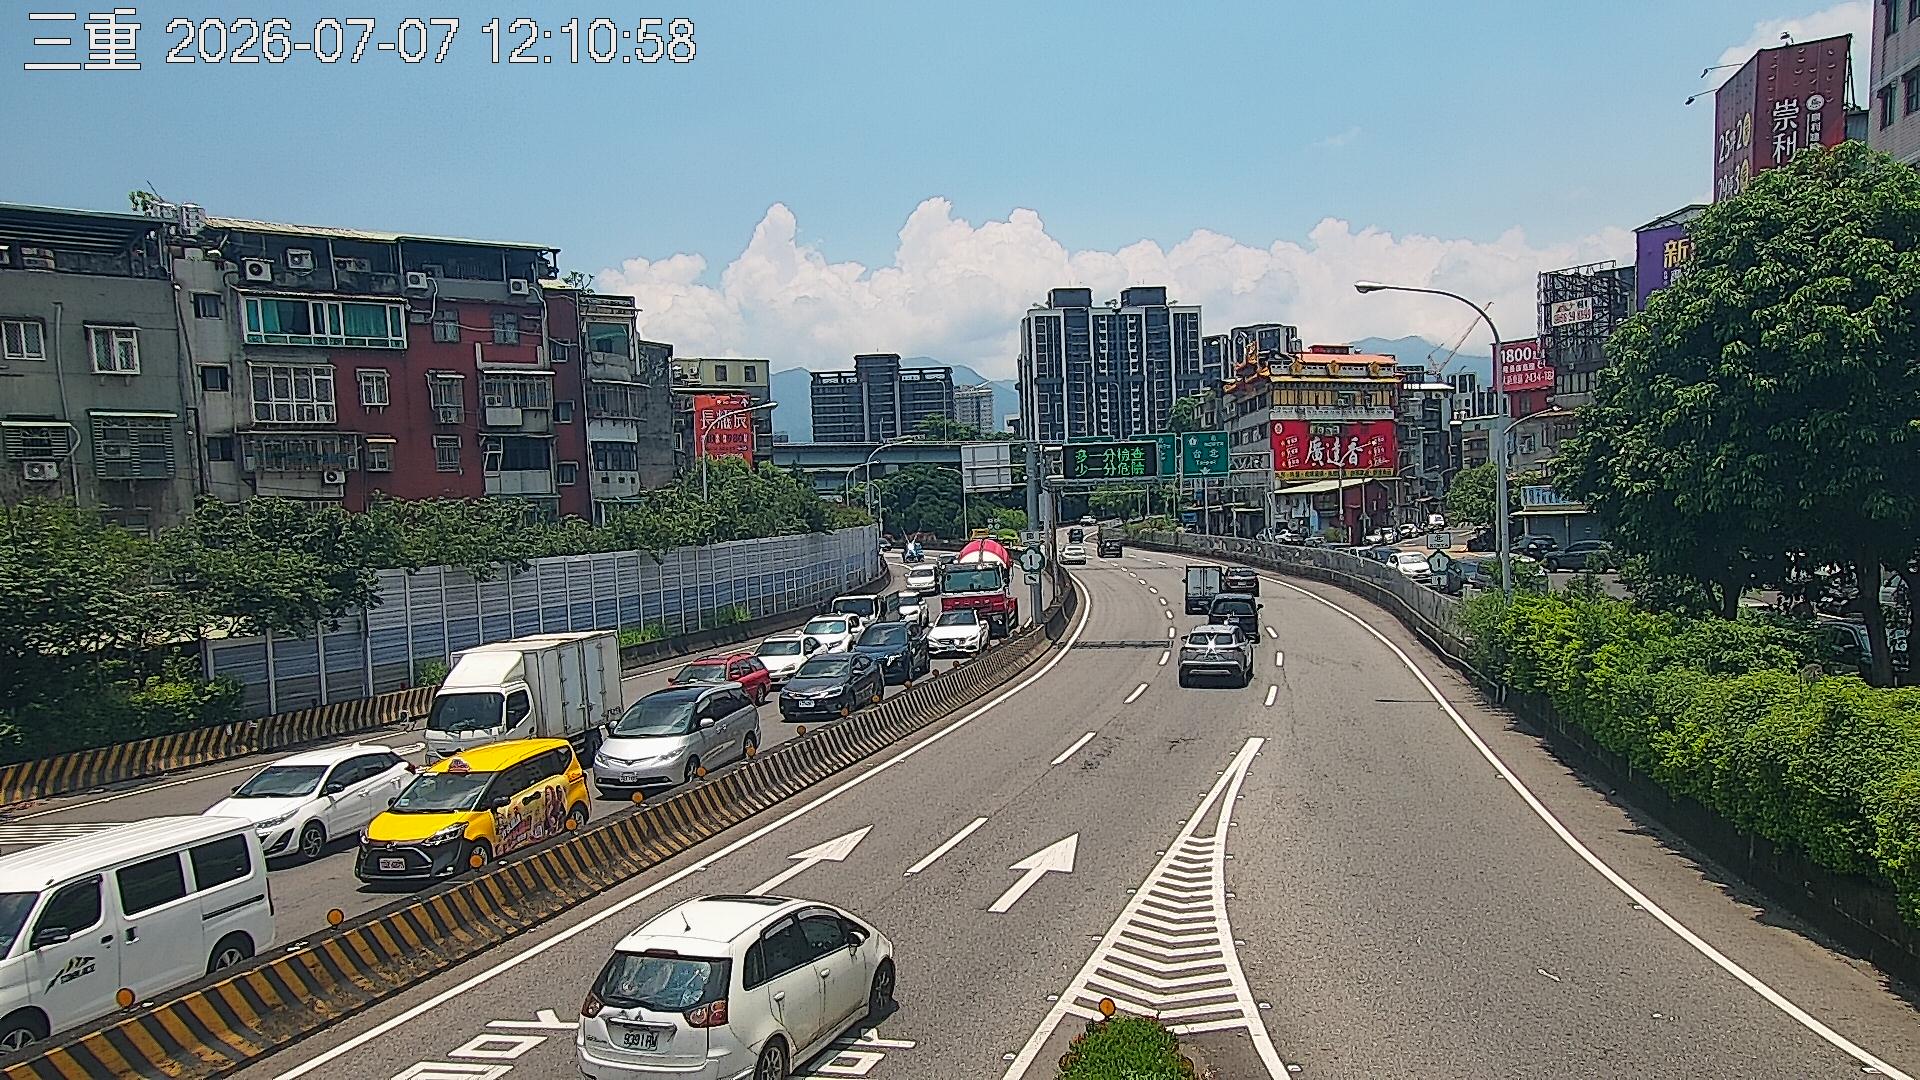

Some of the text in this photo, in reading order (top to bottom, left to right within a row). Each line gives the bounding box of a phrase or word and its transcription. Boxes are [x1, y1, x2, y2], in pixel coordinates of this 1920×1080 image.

[1772, 98, 1799, 170] 崇利
[1663, 238, 1696, 268] 新
[1501, 346, 1532, 364] 1800
[1075, 447, 1145, 462] 多一分檢查
[1074, 461, 1145, 476] 少一分危險
